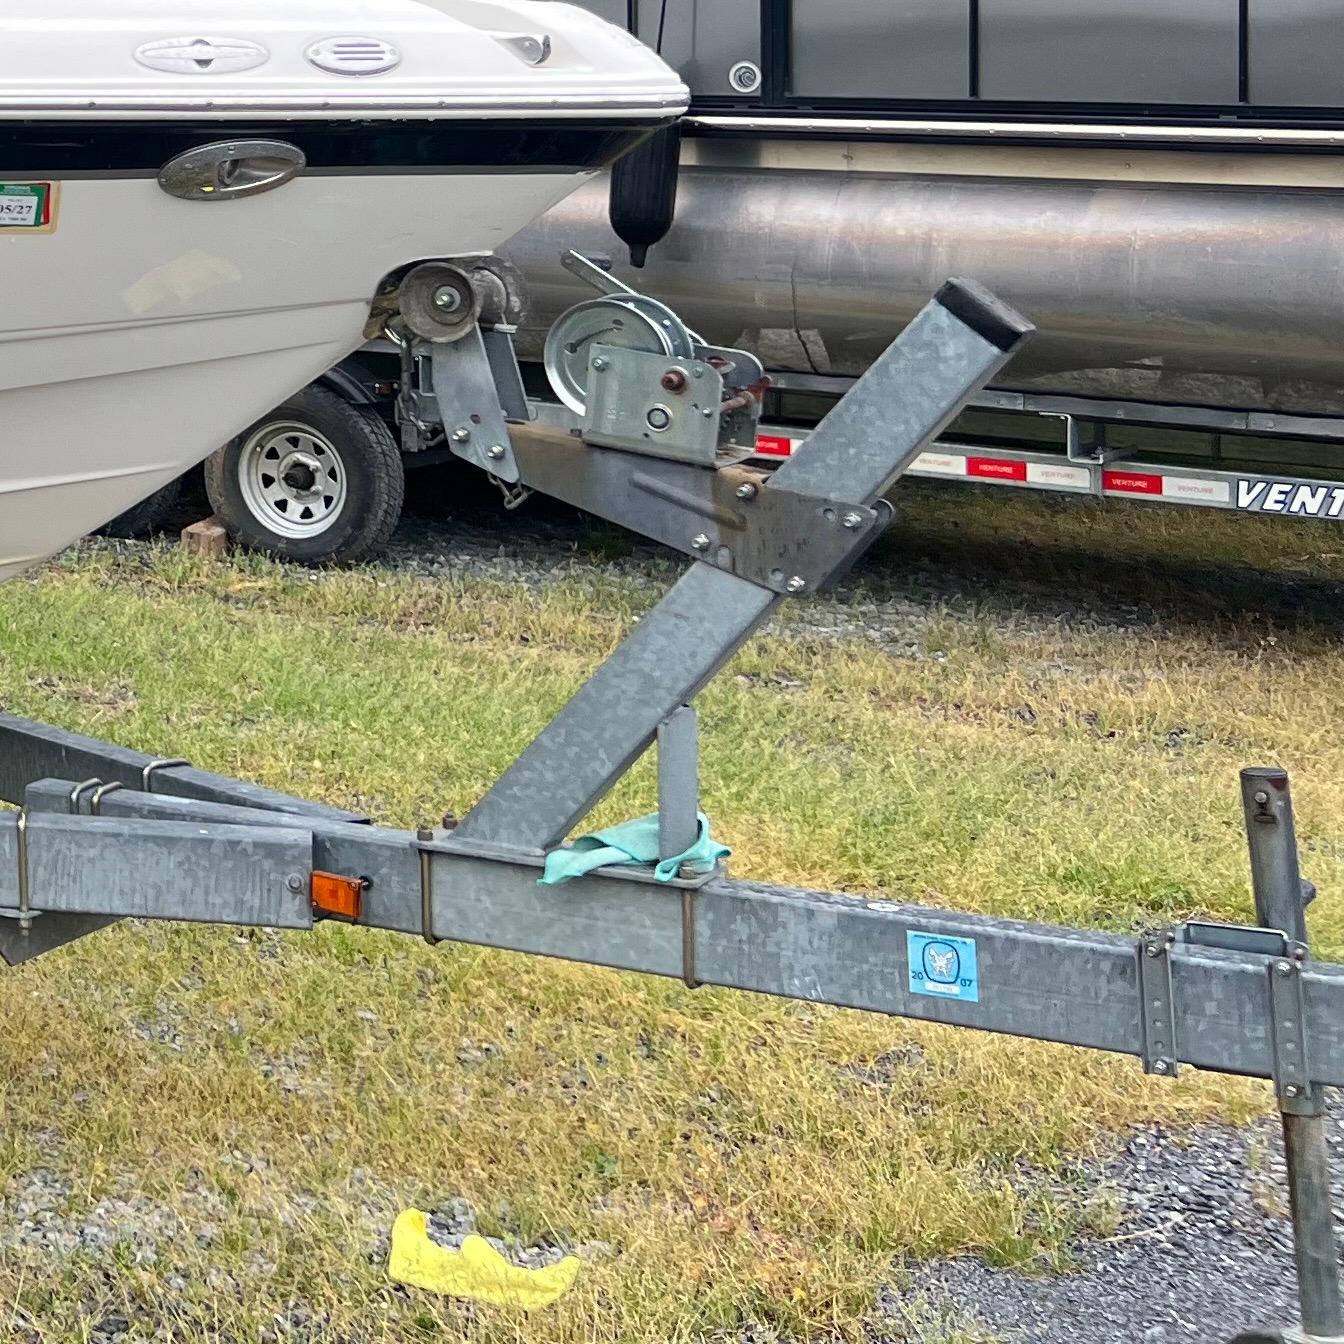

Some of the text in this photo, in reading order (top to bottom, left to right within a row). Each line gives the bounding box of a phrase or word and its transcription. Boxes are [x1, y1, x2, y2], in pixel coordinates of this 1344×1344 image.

[1111, 478, 1148, 488] VENTURE
[911, 970, 924, 980] 20
[960, 978, 973, 988] 07
